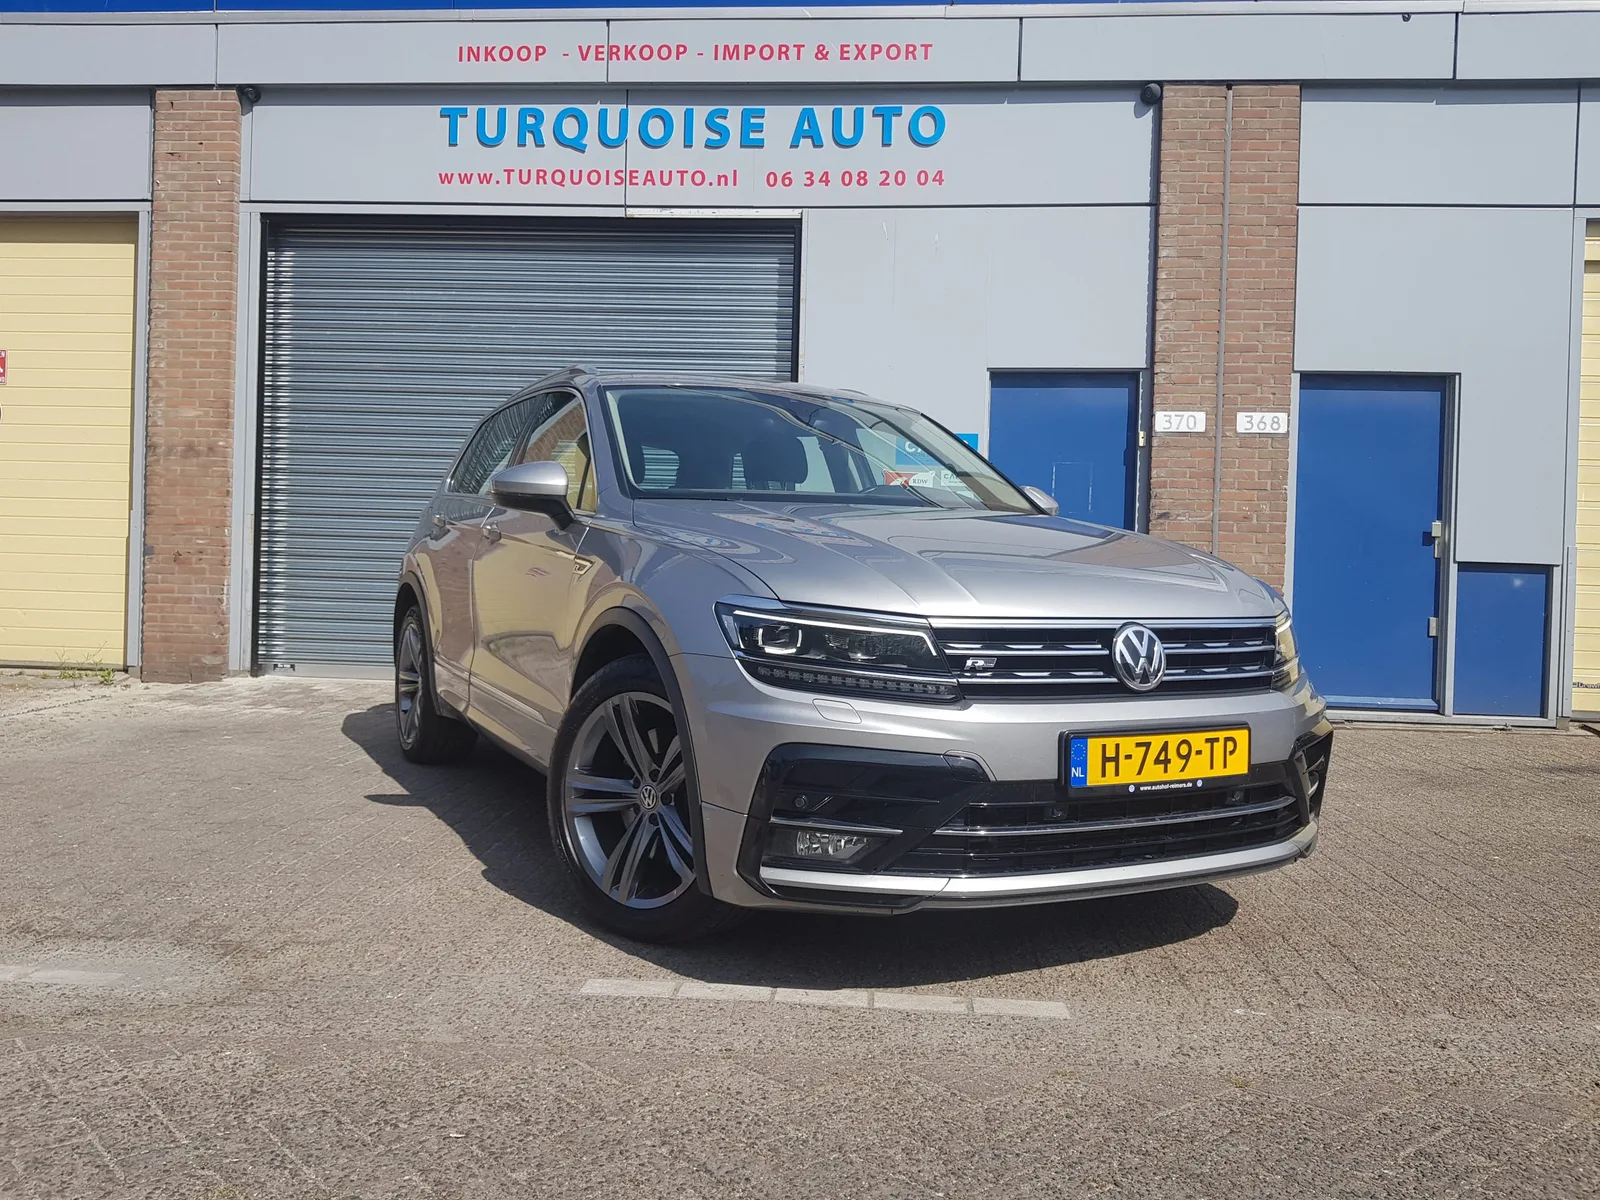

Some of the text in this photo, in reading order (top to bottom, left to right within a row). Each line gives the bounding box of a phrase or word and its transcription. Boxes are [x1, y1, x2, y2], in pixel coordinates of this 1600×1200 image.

[457, 44, 548, 63] INKOOP
[577, 43, 689, 63] VERKOOP
[713, 43, 806, 62] IMPORT
[813, 43, 831, 61] &
[839, 43, 933, 61] EXPORT
[439, 104, 948, 153] TURQUOISE AUTO
[438, 167, 945, 189] www.TURQUOISEAUTO.nl 06 34 08 20 04
[1162, 414, 1197, 430] 370
[1244, 415, 1281, 431] 368
[1101, 736, 1238, 778] H-749-TP
[1071, 766, 1085, 778] NL
